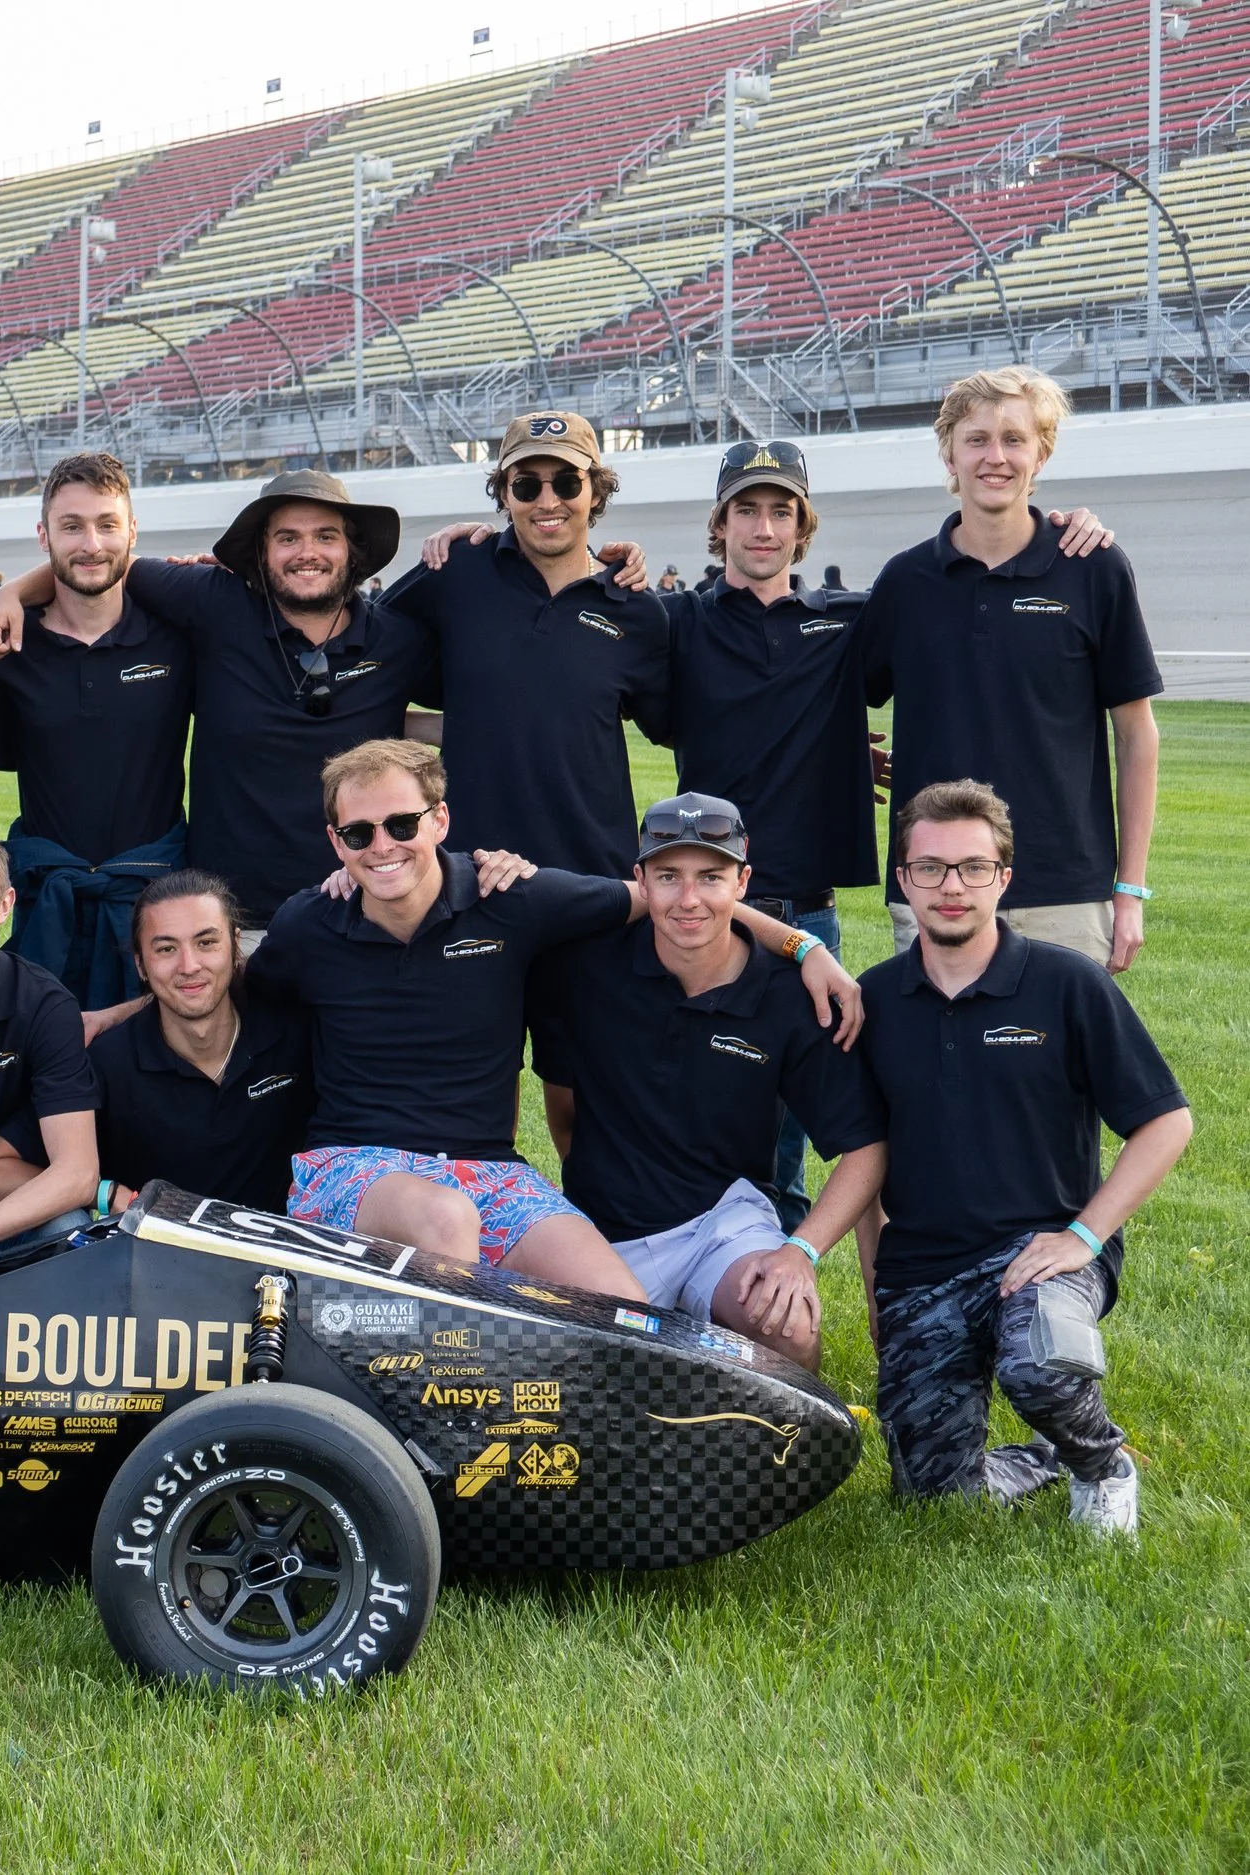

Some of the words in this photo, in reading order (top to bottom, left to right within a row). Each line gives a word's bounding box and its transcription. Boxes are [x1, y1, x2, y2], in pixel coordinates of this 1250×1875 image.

[354, 1316, 386, 1325] YERBA
[390, 1316, 415, 1325] MATE
[430, 1366, 485, 1376] TeXtreme
[421, 1383, 501, 1409] Ansys
[516, 1384, 557, 1397] LIQUI
[5, 1391, 70, 1402] DEATSCH
[516, 1398, 558, 1411] MOLY
[3, 1416, 57, 1430] HMS
[63, 1417, 118, 1428] AURORA
[3, 1429, 57, 1437] motorsport
[485, 1427, 521, 1435] EXTREME
[523, 1426, 559, 1434] CANOPY
[5, 1441, 23, 1450] Law
[6, 1470, 61, 1480] SHORAI
[462, 1466, 503, 1475] tilton
[115, 1442, 227, 1577] Hoosier
[282, 1651, 325, 1674] RACING
